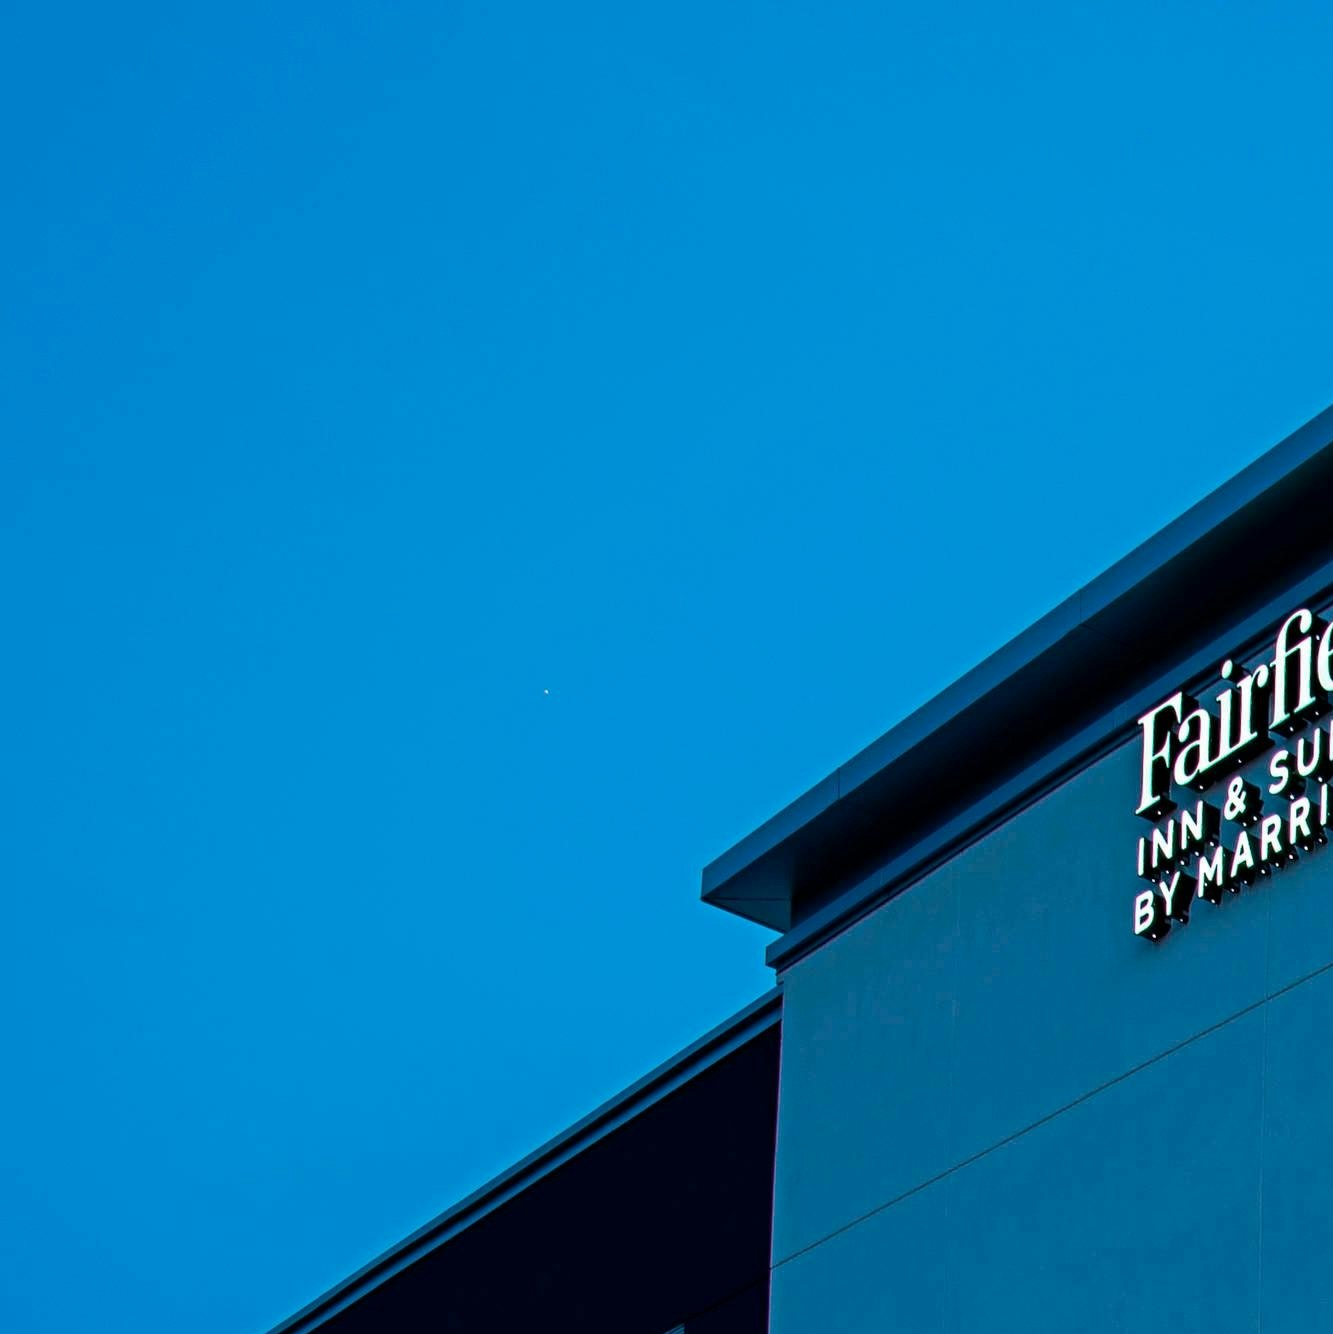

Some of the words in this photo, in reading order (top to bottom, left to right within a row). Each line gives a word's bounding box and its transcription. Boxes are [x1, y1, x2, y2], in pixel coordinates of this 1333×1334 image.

[1137, 800, 1203, 877] INN
[1222, 775, 1248, 821] &
[1134, 871, 1181, 936] BY
